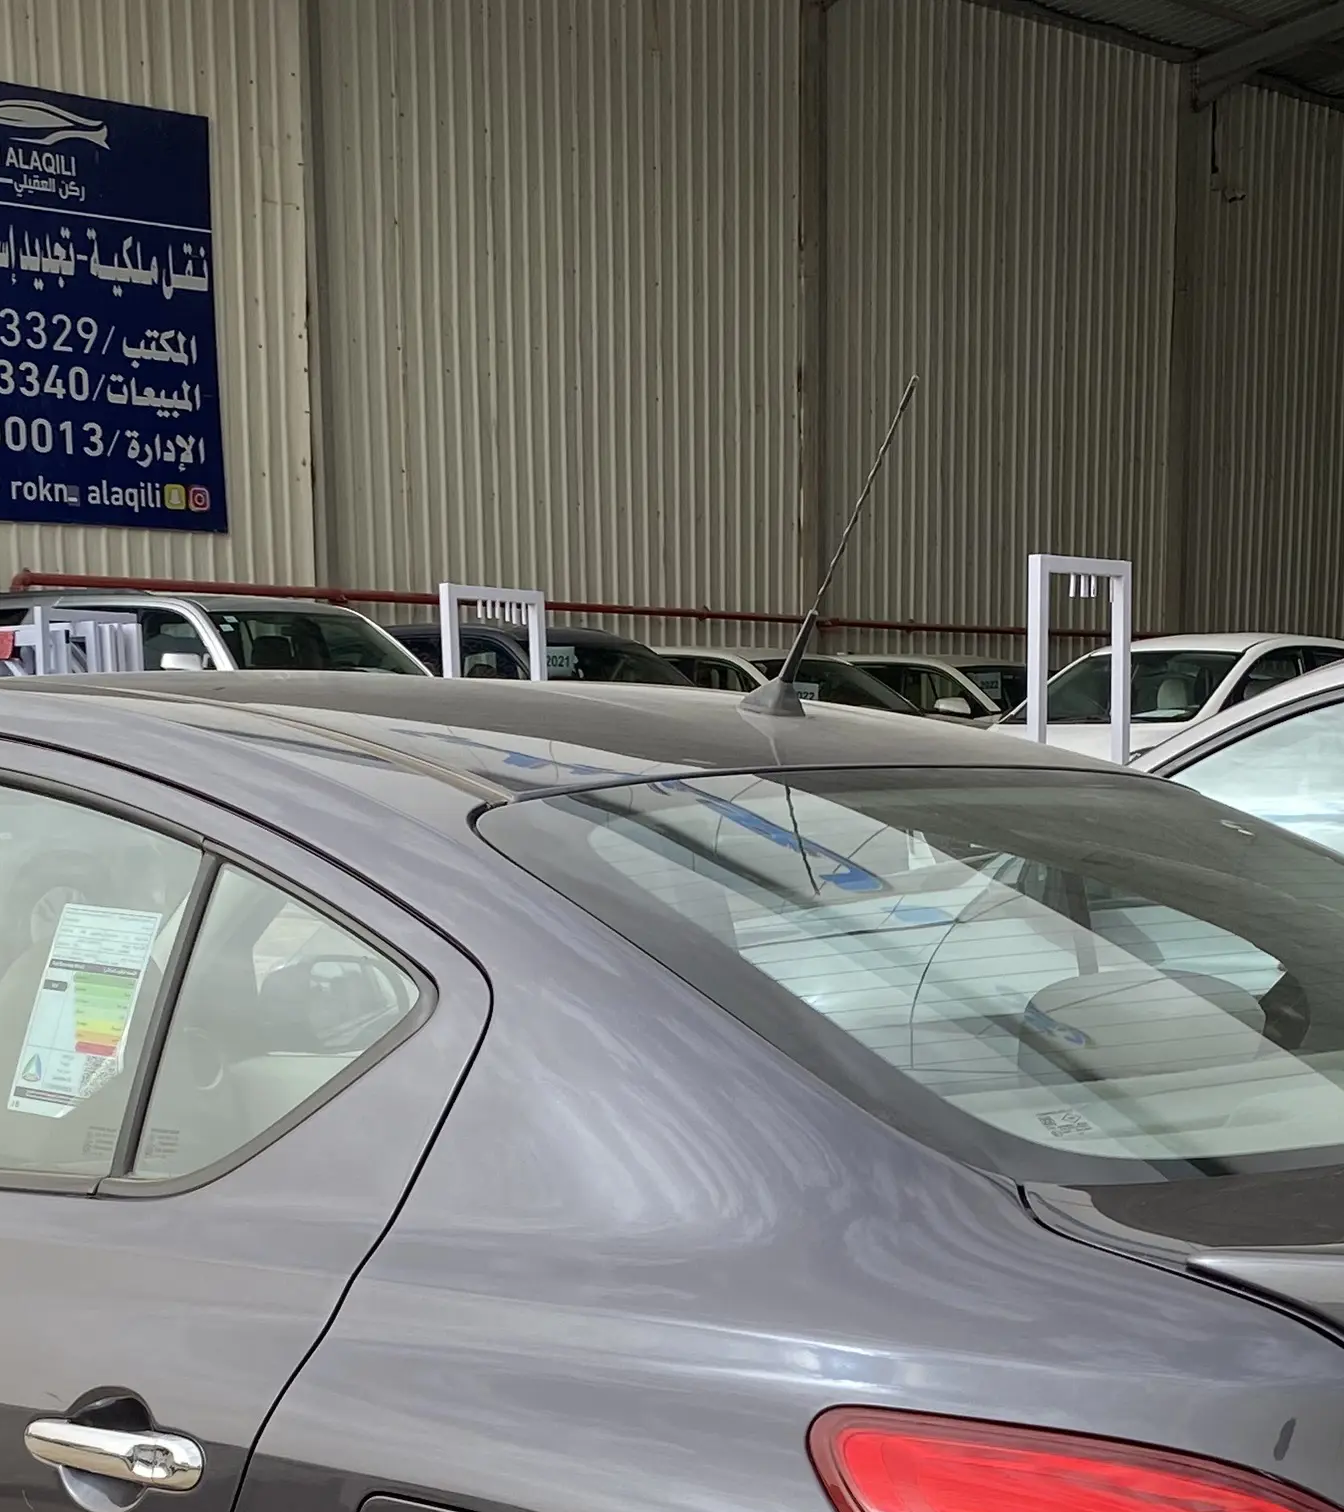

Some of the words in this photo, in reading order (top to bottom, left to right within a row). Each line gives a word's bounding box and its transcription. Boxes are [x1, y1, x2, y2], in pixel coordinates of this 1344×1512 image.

[5, 146, 77, 177] ALAQILI
[13, 173, 56, 198] العقيلي
[58, 179, 86, 202] ركن
[162, 242, 209, 300] نقل
[546, 654, 570, 668] 2021
